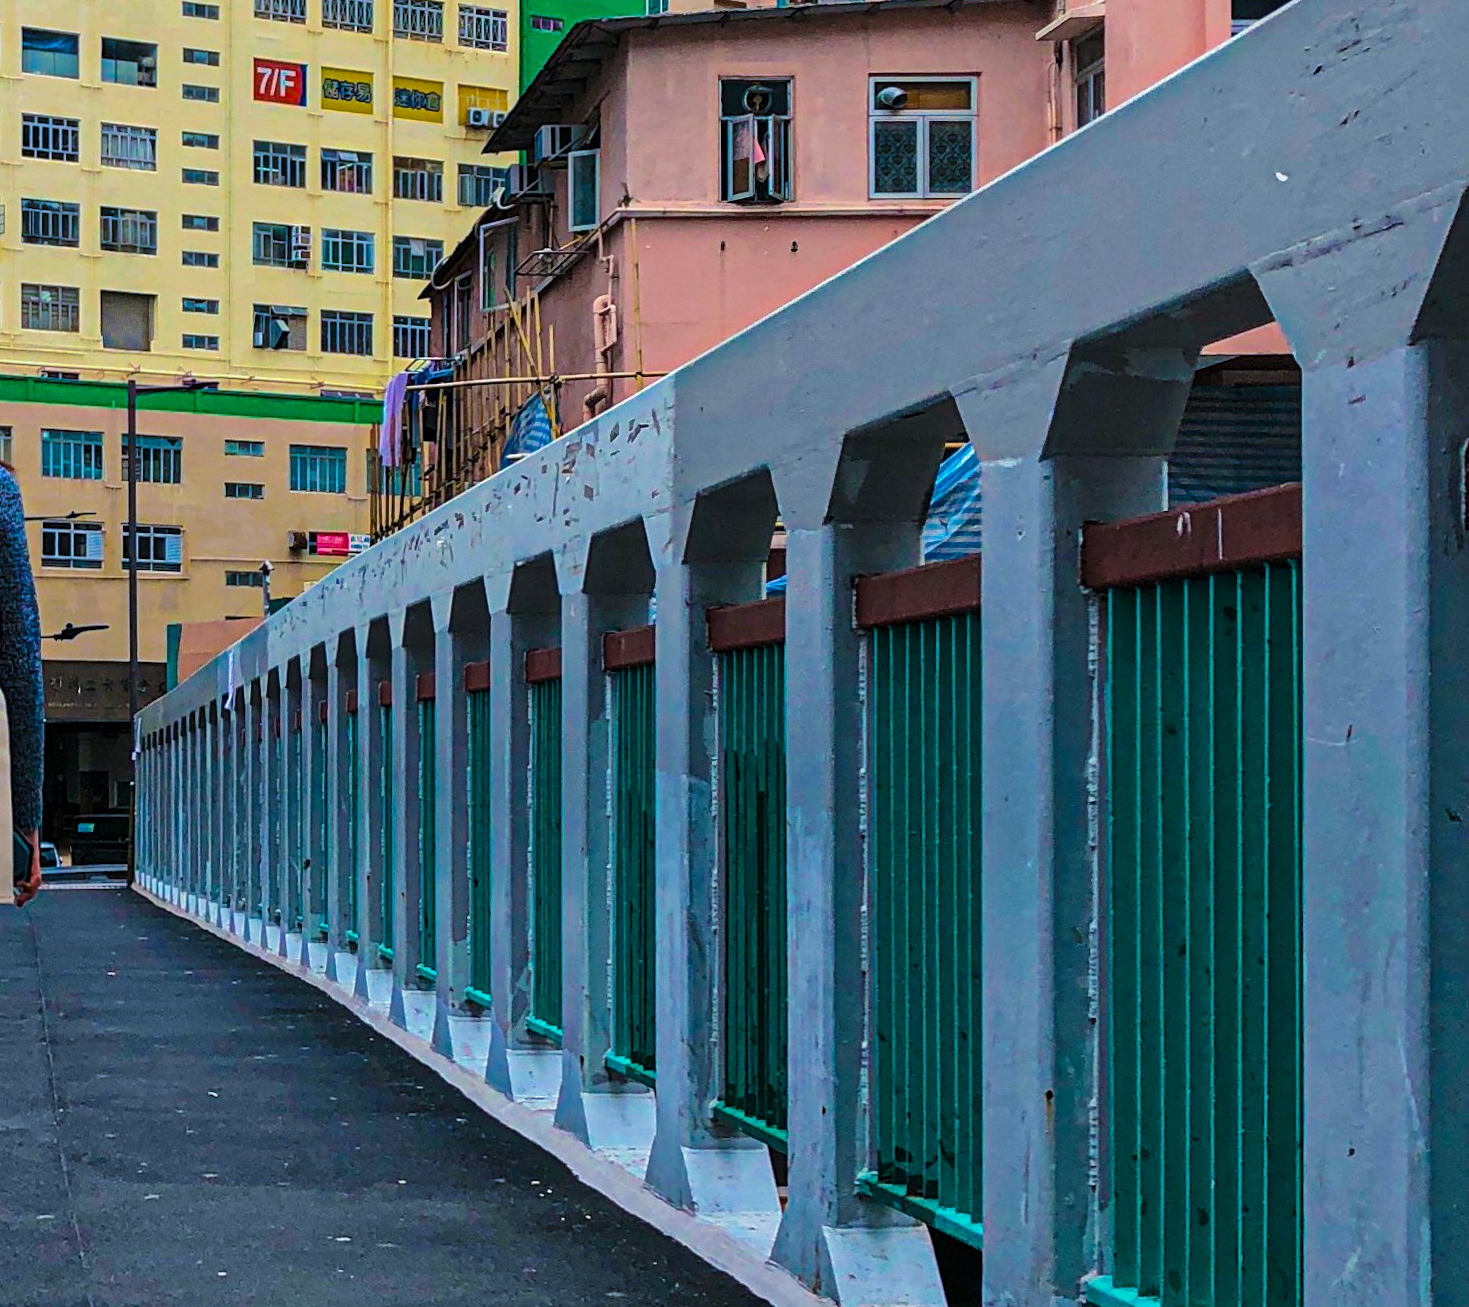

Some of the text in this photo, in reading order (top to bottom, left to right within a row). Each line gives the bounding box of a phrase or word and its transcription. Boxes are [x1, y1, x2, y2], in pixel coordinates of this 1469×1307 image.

[256, 67, 296, 97] 7/F
[323, 78, 440, 112] 儲存易 迷你倉
